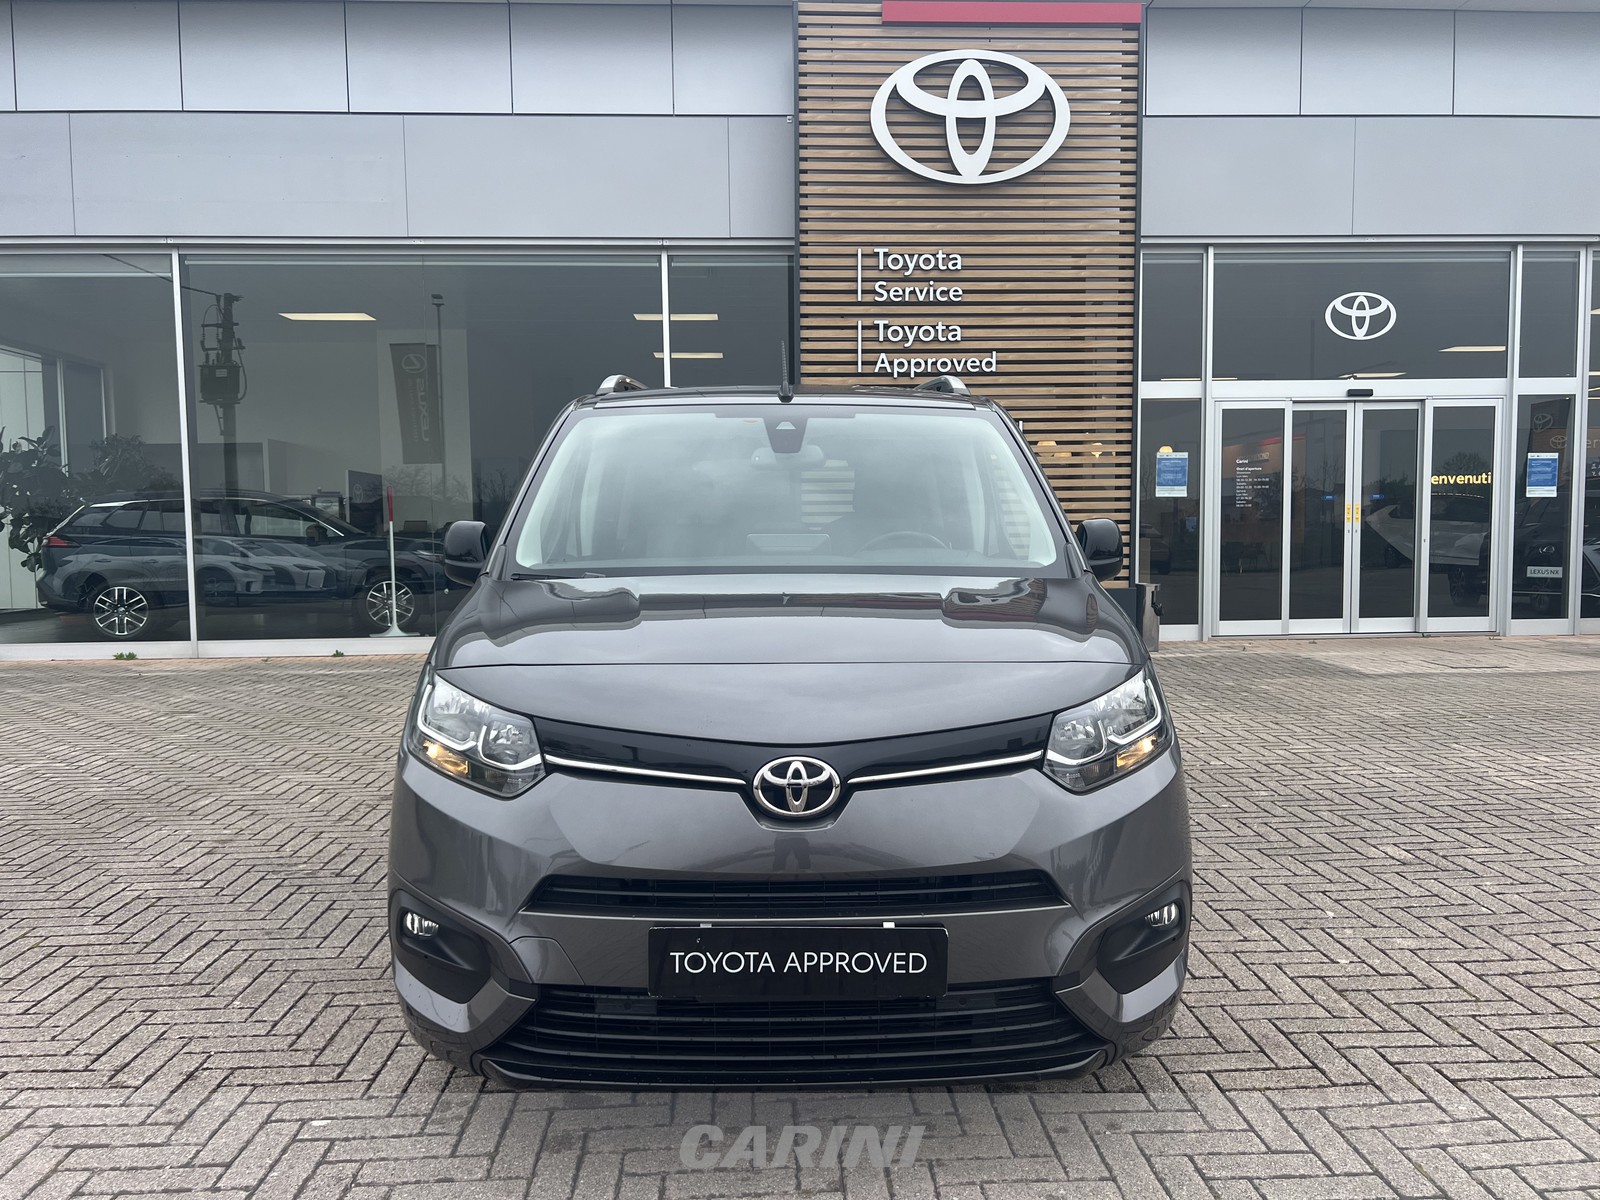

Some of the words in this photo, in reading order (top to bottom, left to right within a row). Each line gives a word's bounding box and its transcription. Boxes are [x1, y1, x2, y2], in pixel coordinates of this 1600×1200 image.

[873, 248, 962, 276] Toyota
[873, 281, 963, 301] Service
[873, 320, 962, 347] Toyota
[874, 350, 997, 378] Approved
[1431, 472, 1492, 484] envenuti
[670, 952, 775, 973] TOYOTA
[783, 952, 927, 973] APPROVED
